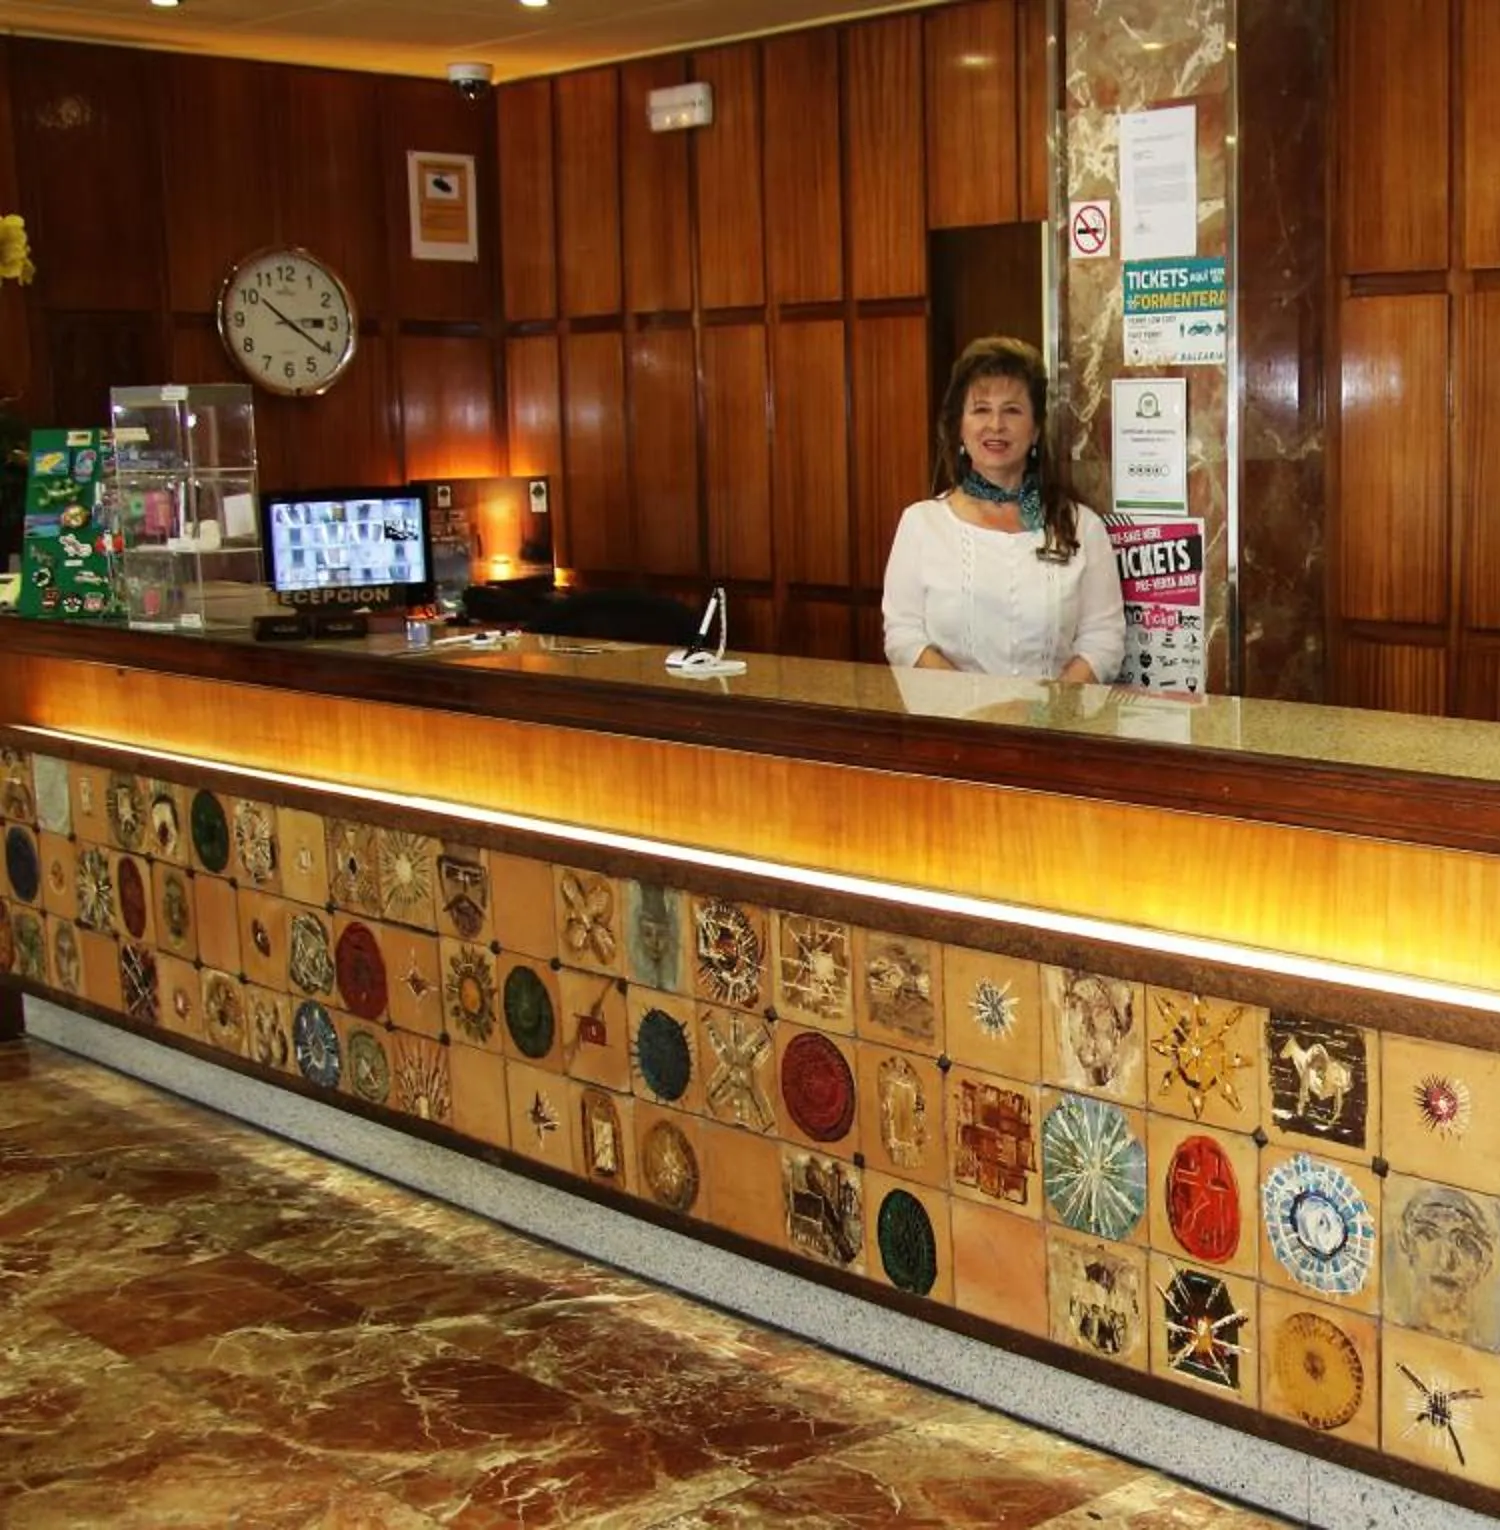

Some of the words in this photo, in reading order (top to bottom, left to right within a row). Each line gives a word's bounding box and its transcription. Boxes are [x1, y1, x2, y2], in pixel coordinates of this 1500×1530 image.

[256, 272, 272, 288] 11
[276, 265, 295, 282] 12
[305, 275, 313, 289] 1
[1126, 267, 1188, 290] TICKETS
[240, 288, 259, 305] 10
[320, 292, 331, 309] 2
[1132, 289, 1226, 311] FORMENTERA
[233, 311, 245, 328] 9
[327, 315, 339, 332] 3
[243, 336, 255, 353] 8
[262, 354, 273, 371] 7
[284, 361, 296, 378] 6
[306, 356, 317, 373] 5
